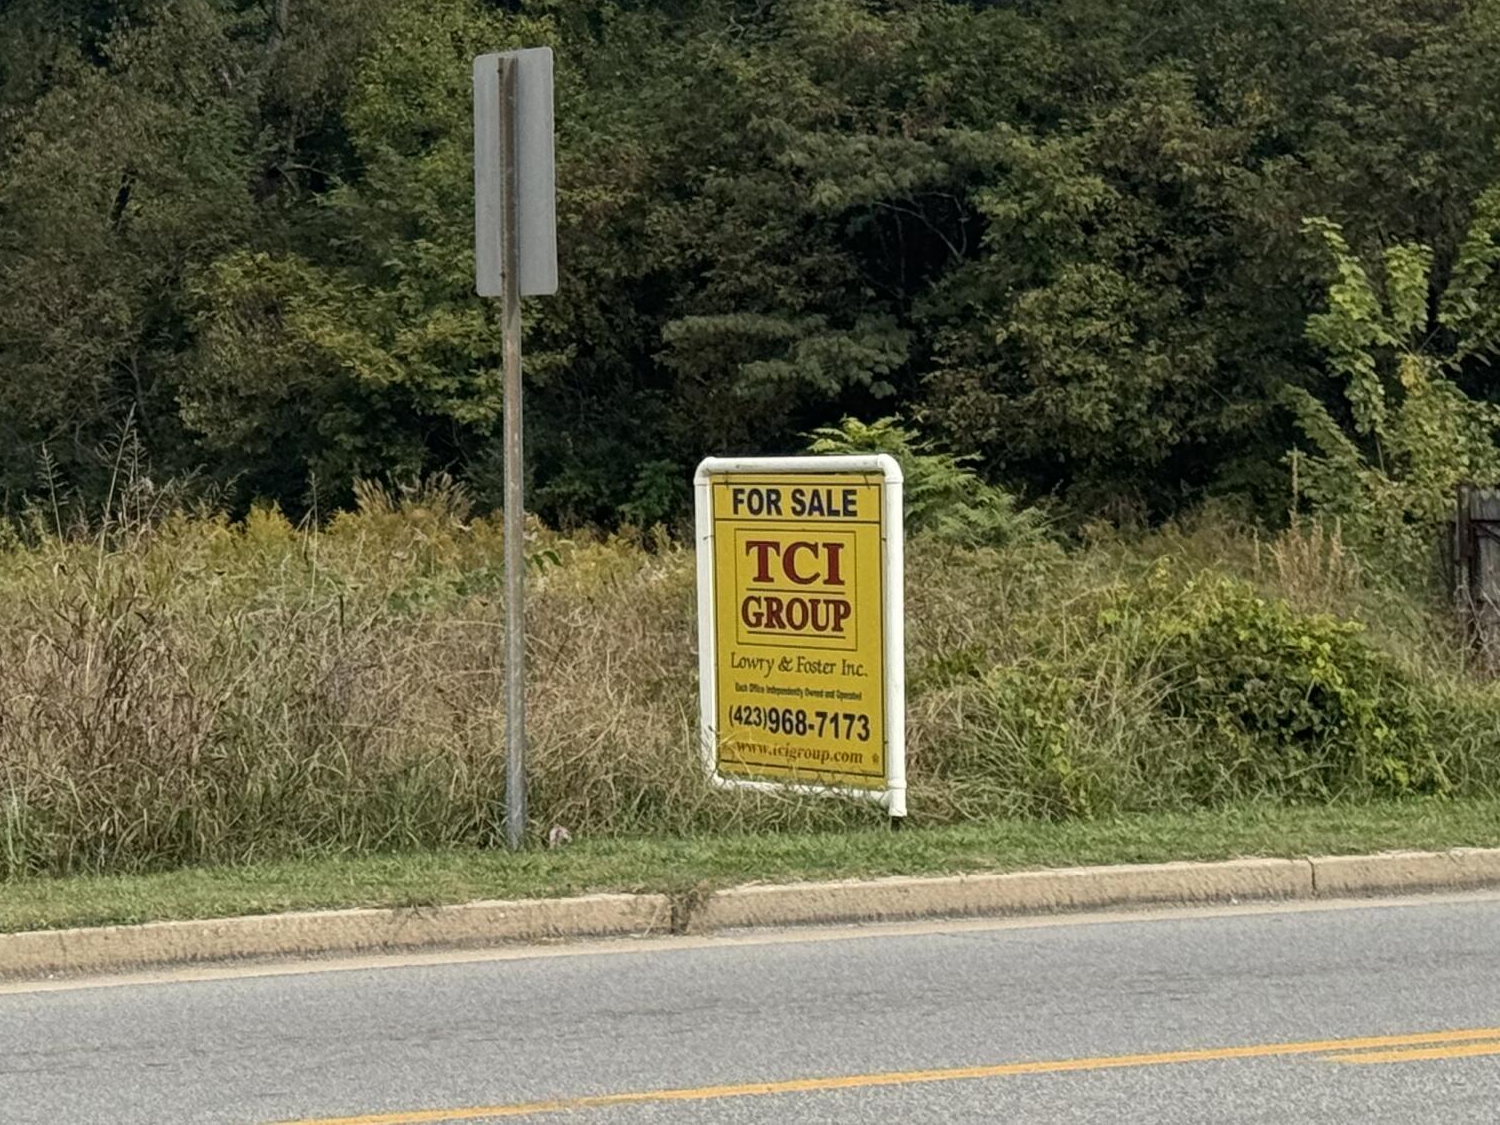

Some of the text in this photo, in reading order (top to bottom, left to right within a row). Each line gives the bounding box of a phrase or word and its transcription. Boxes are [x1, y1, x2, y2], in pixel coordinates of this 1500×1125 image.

[732, 488, 858, 517] FOR SALE
[745, 540, 845, 585] TCI
[741, 595, 852, 632] GROUP
[730, 652, 868, 678] Lowry & Foster Inc.
